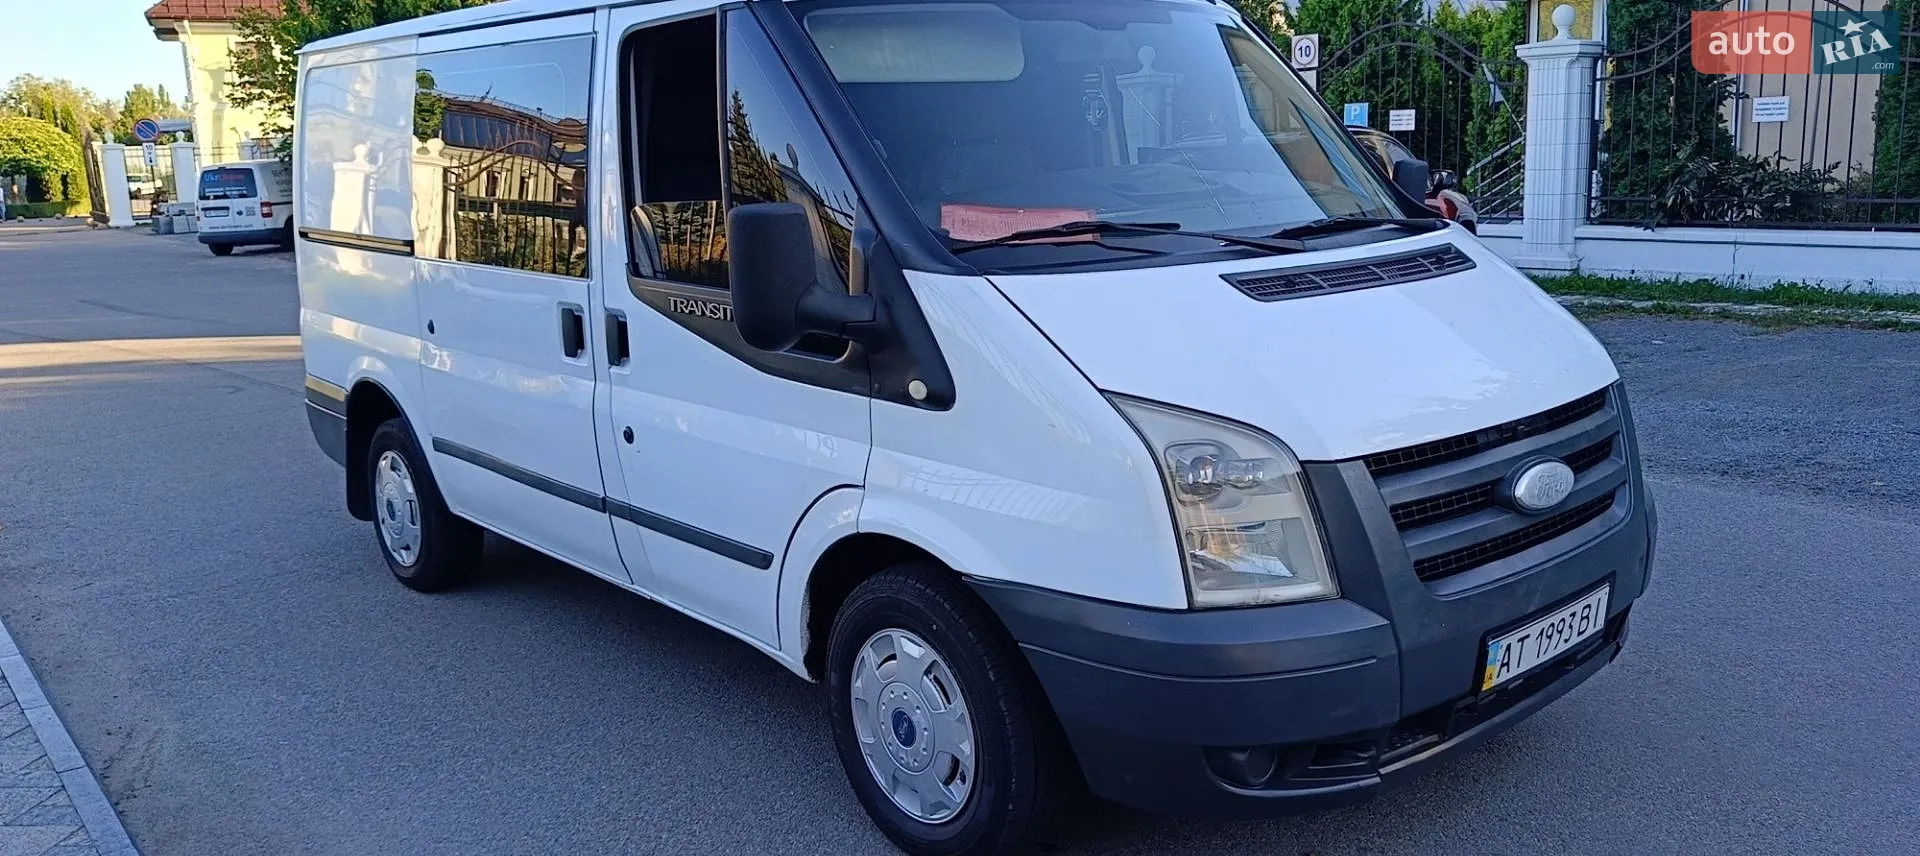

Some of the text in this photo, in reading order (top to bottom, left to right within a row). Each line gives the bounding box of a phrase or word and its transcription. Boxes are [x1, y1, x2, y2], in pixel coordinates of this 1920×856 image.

[1298, 45, 1312, 58] 10
[1351, 105, 1360, 120] P
[668, 296, 733, 321] TRANSIT
[1497, 597, 1602, 678] AT 1993 BI
